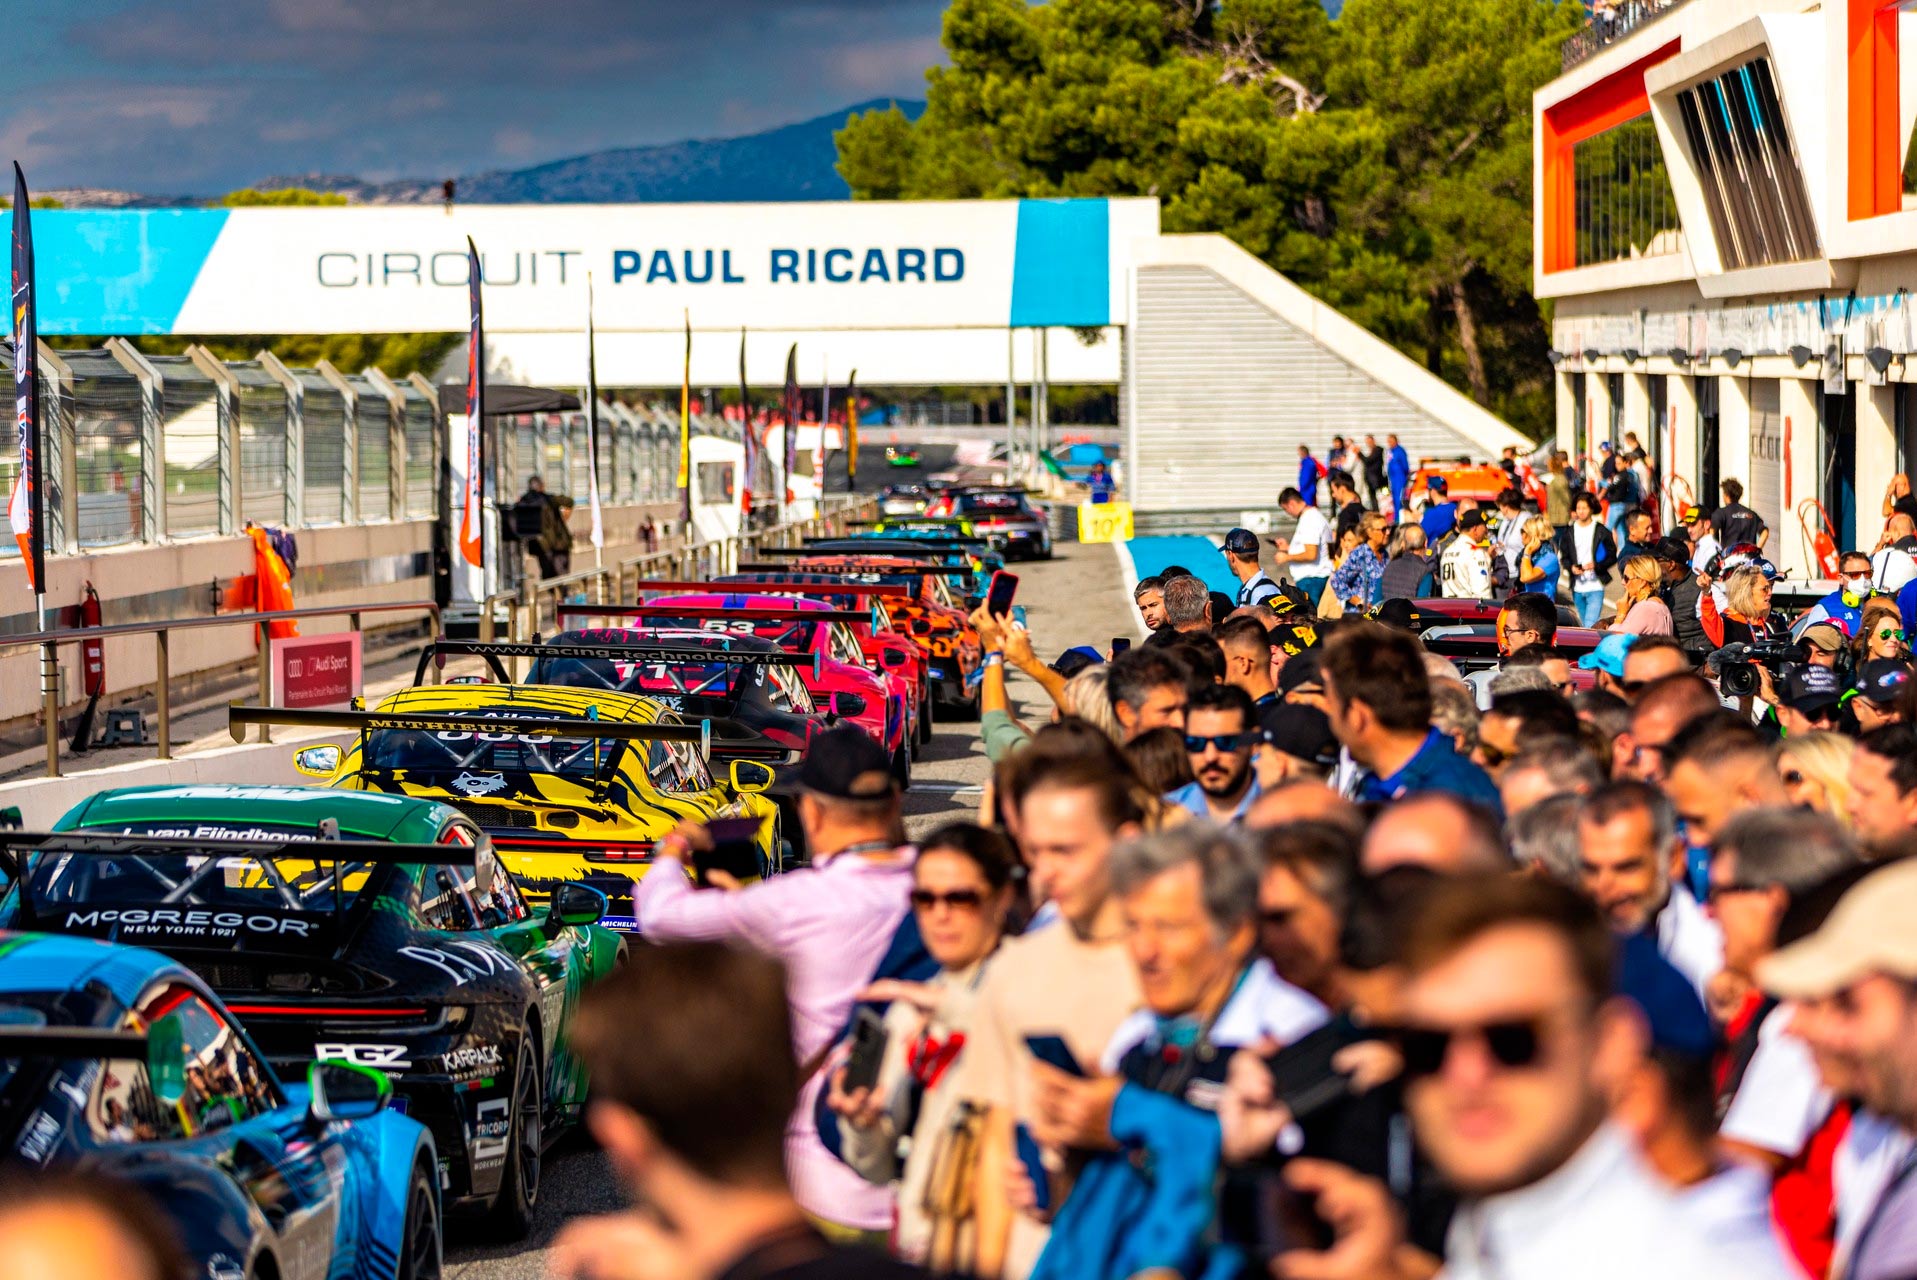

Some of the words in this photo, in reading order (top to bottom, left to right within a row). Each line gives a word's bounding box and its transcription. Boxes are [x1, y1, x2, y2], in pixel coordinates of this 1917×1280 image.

[318, 251, 582, 287] CIRCUIT
[613, 250, 745, 284] PAUL
[771, 247, 965, 283] RICARD
[703, 620, 754, 634] 53
[467, 645, 784, 664] www.racing-technology.fr
[316, 656, 330, 672] Audi
[331, 655, 348, 673] Sport
[368, 719, 521, 733] MITHIEUX
[123, 925, 161, 935] NEW
[165, 926, 206, 935] YORK
[211, 927, 236, 938] 1921
[601, 920, 638, 928] MICHELIN
[441, 1046, 503, 1073] KARPACK
[477, 1121, 508, 1137] TRICORP
